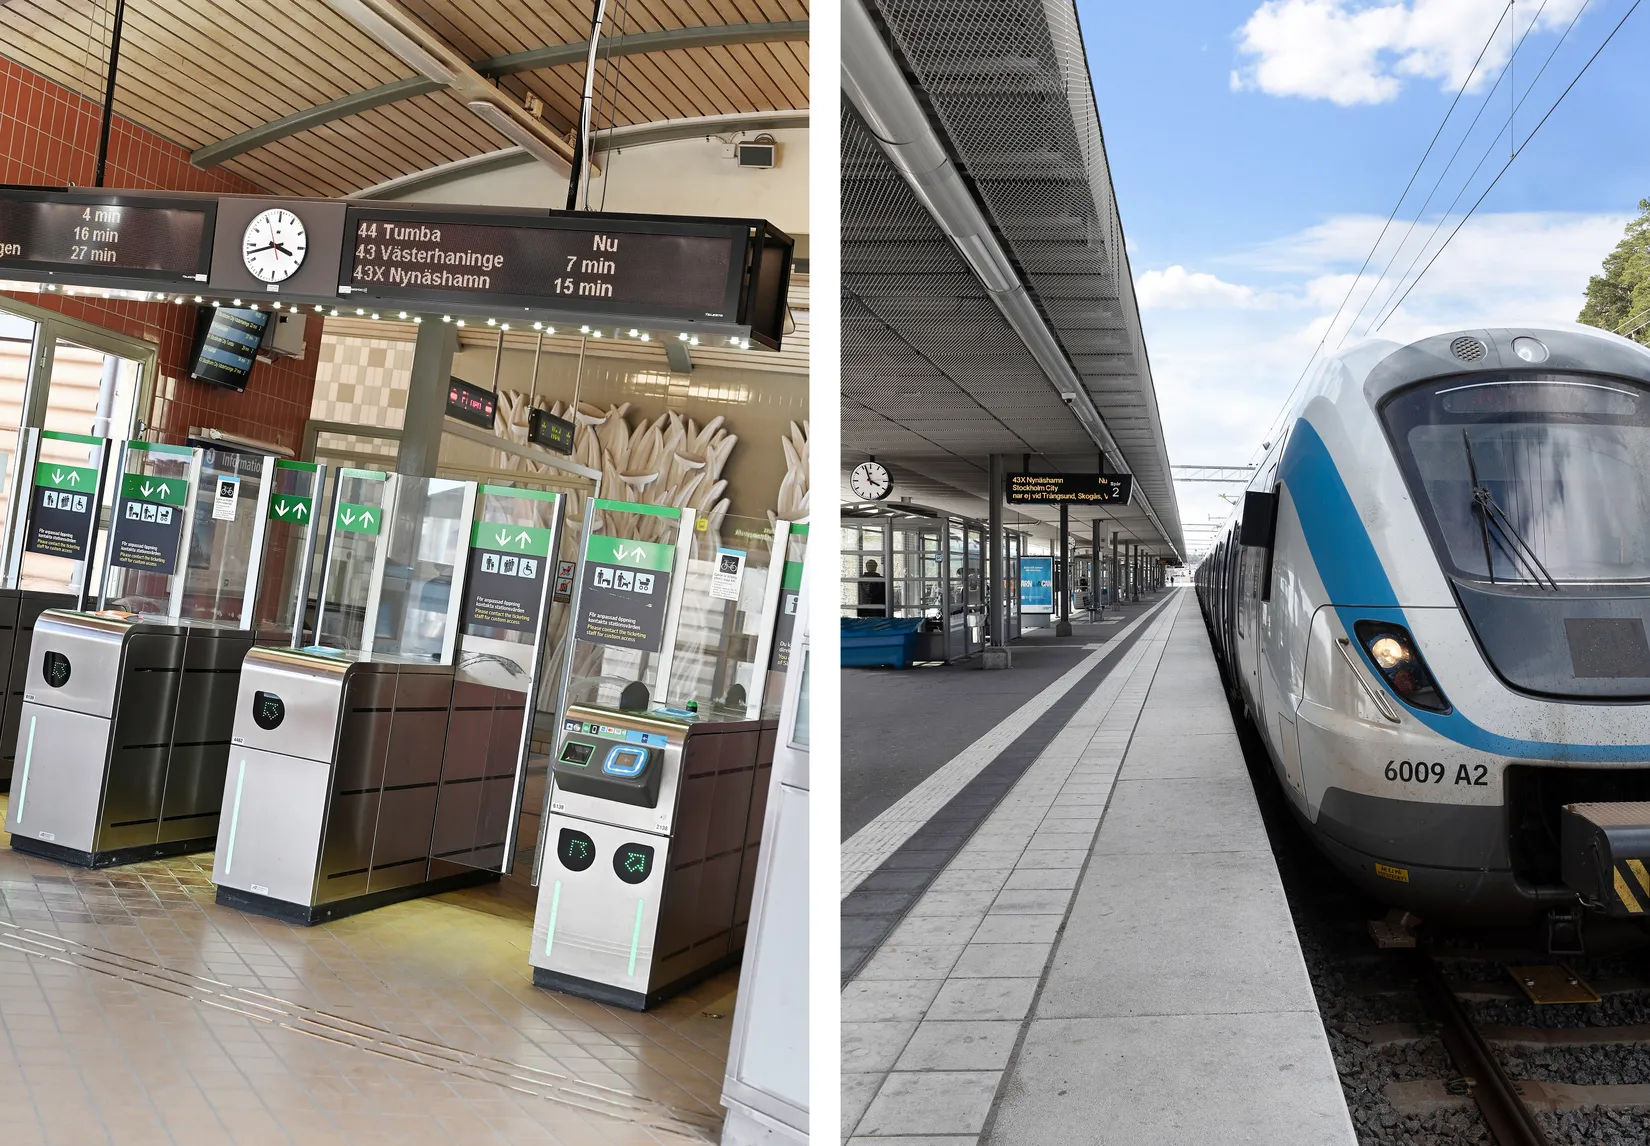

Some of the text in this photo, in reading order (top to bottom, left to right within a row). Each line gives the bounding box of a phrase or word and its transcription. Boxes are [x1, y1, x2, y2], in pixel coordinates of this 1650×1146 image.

[83, 208, 120, 223] 4 min
[74, 226, 119, 242] 16 min
[358, 222, 441, 242] 44 Tumba
[593, 234, 618, 252] Nu
[71, 246, 117, 262] 27 min
[356, 244, 504, 271] 43 Västerhaninge
[567, 256, 615, 275] 7 min
[353, 265, 490, 288] 43X Nynäshamn
[554, 278, 613, 297] 15 min
[1026, 477, 1064, 485] Nynäshamn
[1045, 485, 1058, 493] City
[1042, 492, 1076, 500] Trångsund,
[1077, 492, 1102, 501] Skogås,
[1112, 488, 1119, 497] 2
[627, 630, 646, 639] ticketing
[1385, 760, 1488, 786] 6009 A2
